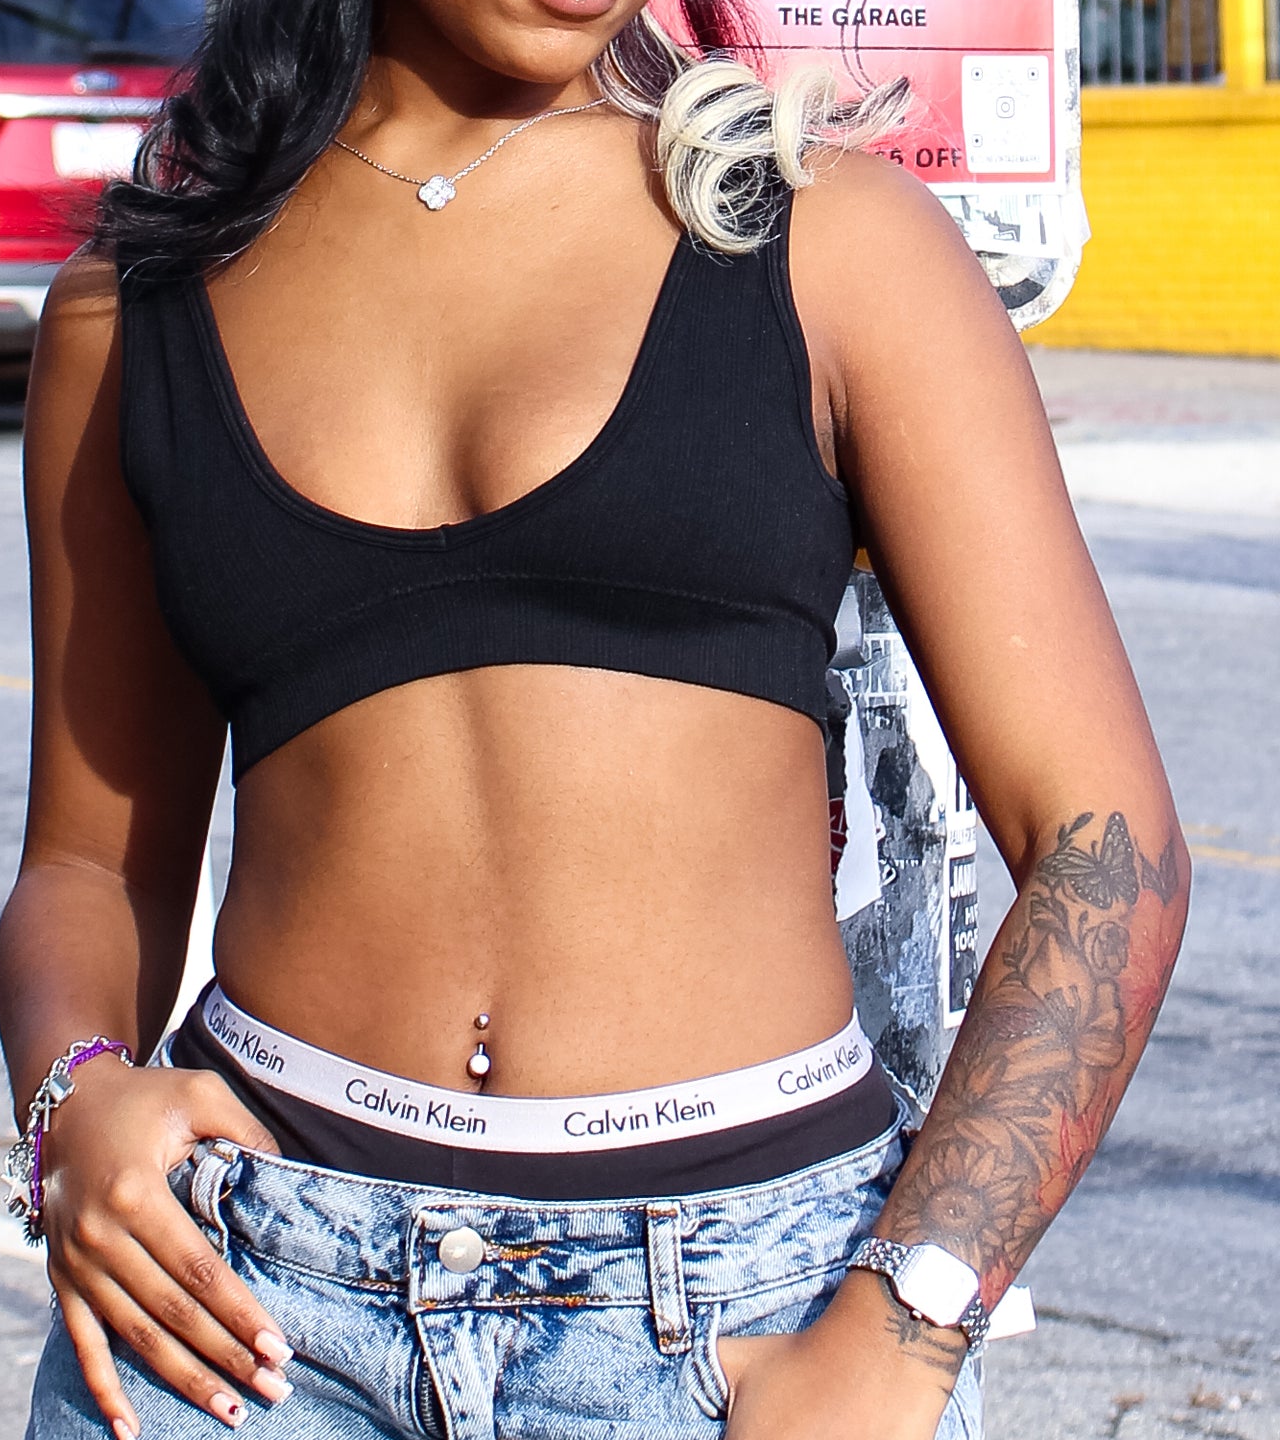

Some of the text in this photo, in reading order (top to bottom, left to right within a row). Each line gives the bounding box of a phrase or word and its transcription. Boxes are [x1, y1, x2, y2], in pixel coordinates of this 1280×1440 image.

[778, 6, 927, 28] THE GARAGE
[915, 147, 964, 168] OFF
[208, 1002, 286, 1074] Calvin Klein
[777, 1038, 864, 1096] Calvin Klein
[345, 1078, 487, 1135] Calvin Klein
[563, 1093, 716, 1138] Calvin Klein
